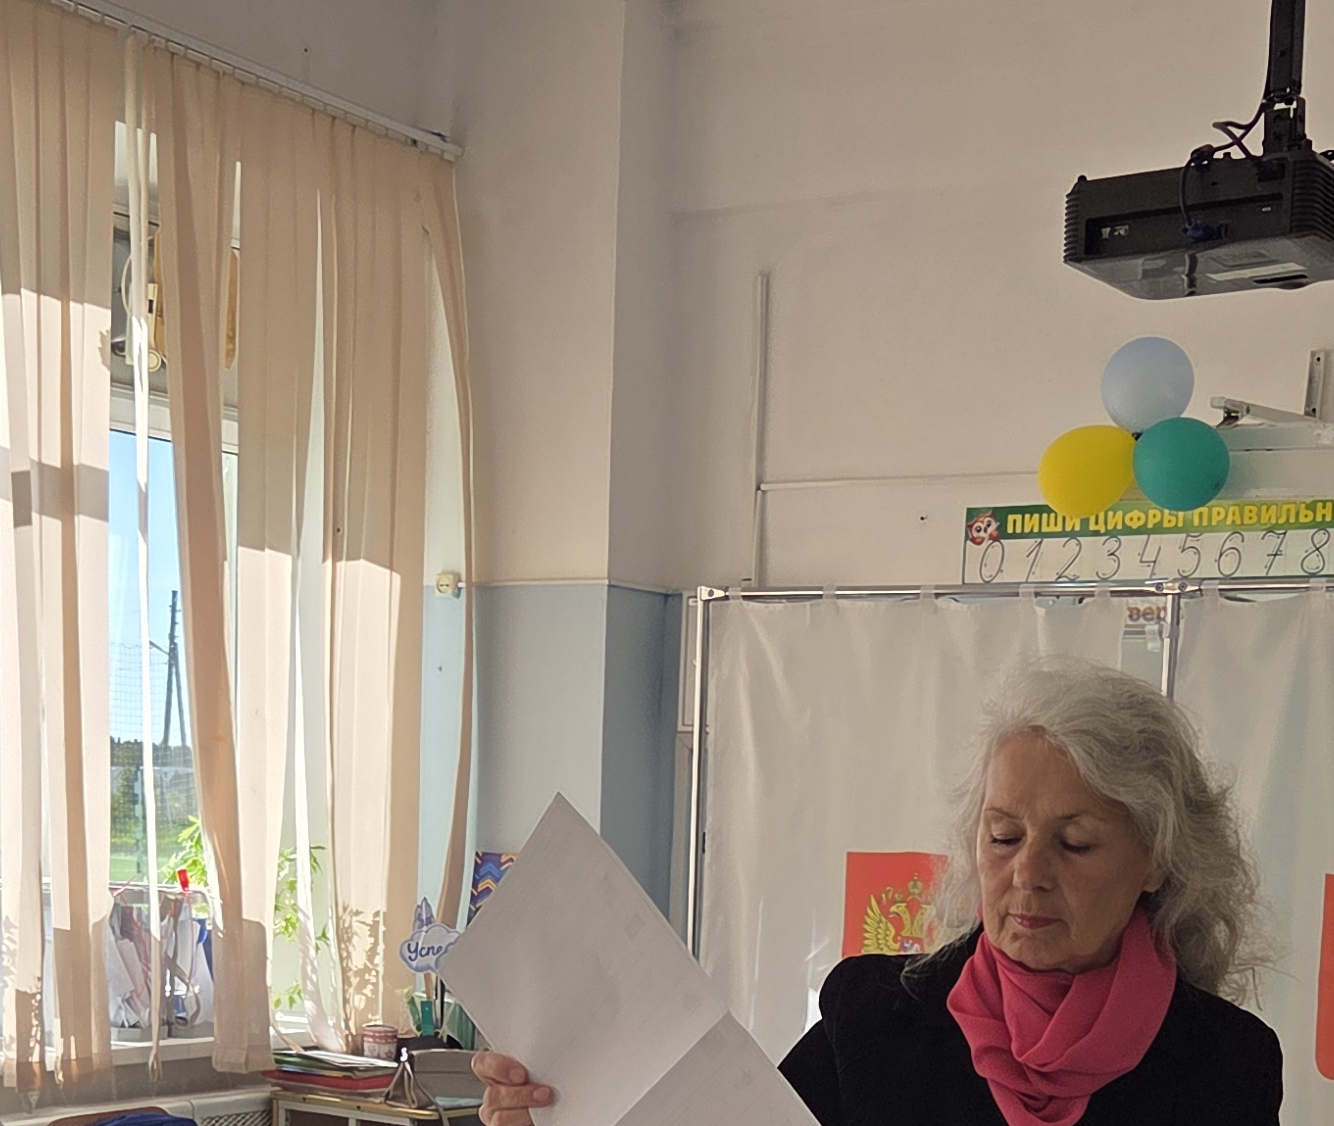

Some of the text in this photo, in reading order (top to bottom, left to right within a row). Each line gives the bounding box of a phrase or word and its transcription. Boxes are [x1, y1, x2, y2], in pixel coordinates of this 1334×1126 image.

[1007, 513, 1081, 534] ПИШИ
[1089, 509, 1184, 533] ЦИФРЫ
[979, 539, 1005, 584] 0
[1026, 538, 1043, 582] 1
[1055, 537, 1082, 581] 2
[1096, 536, 1122, 580] 3
[1139, 535, 1162, 579] 4
[1177, 533, 1203, 578] 5
[1216, 531, 1245, 578] 6
[1261, 530, 1288, 576] 7
[1300, 528, 1331, 575] 8
